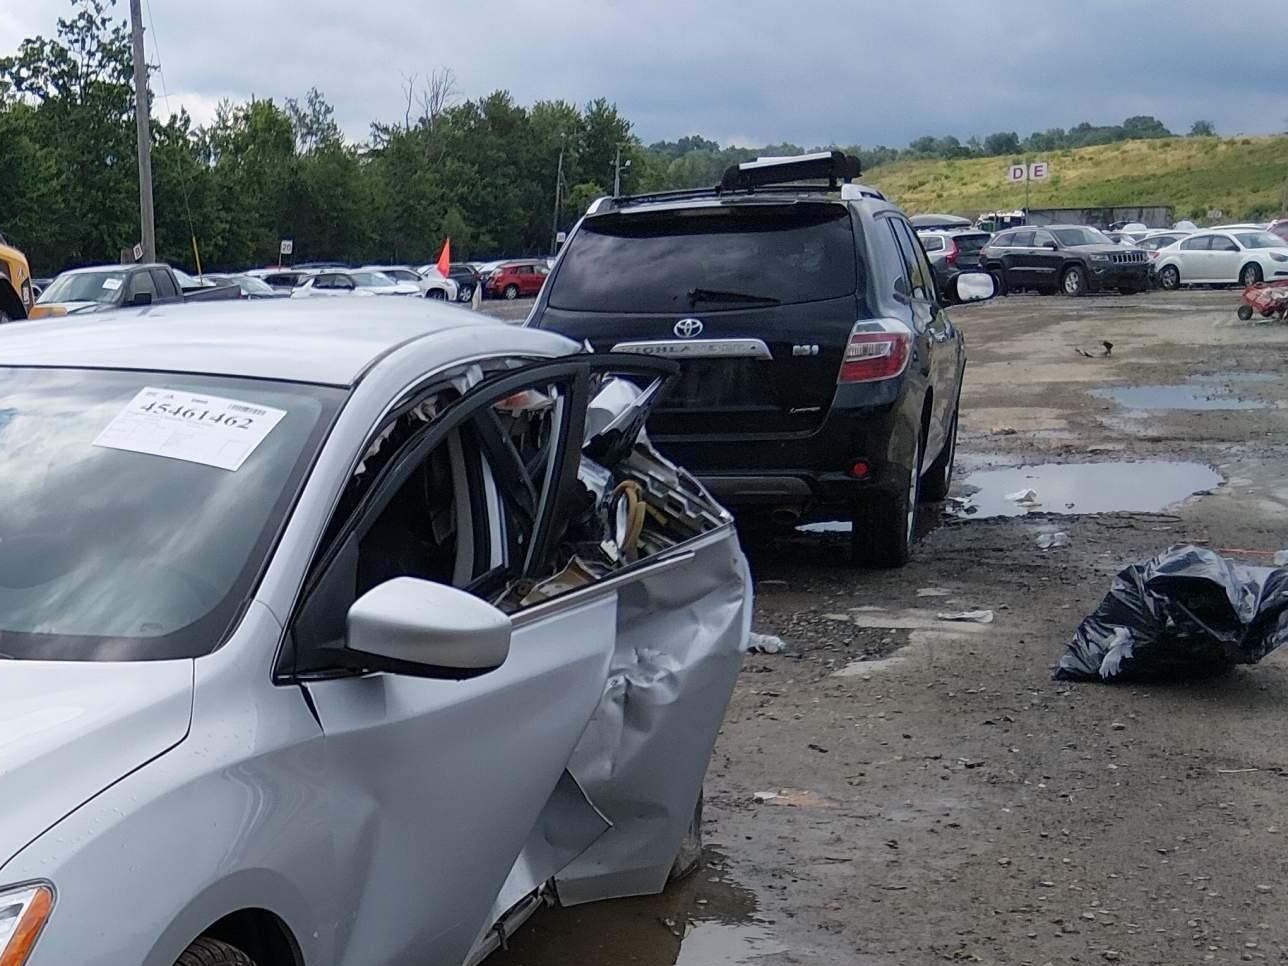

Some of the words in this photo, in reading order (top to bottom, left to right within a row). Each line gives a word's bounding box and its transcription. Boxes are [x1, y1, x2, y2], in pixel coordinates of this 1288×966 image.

[1013, 167, 1024, 180] D
[1034, 165, 1044, 177] E
[282, 243, 292, 252] 20
[140, 401, 254, 429] 45461462
